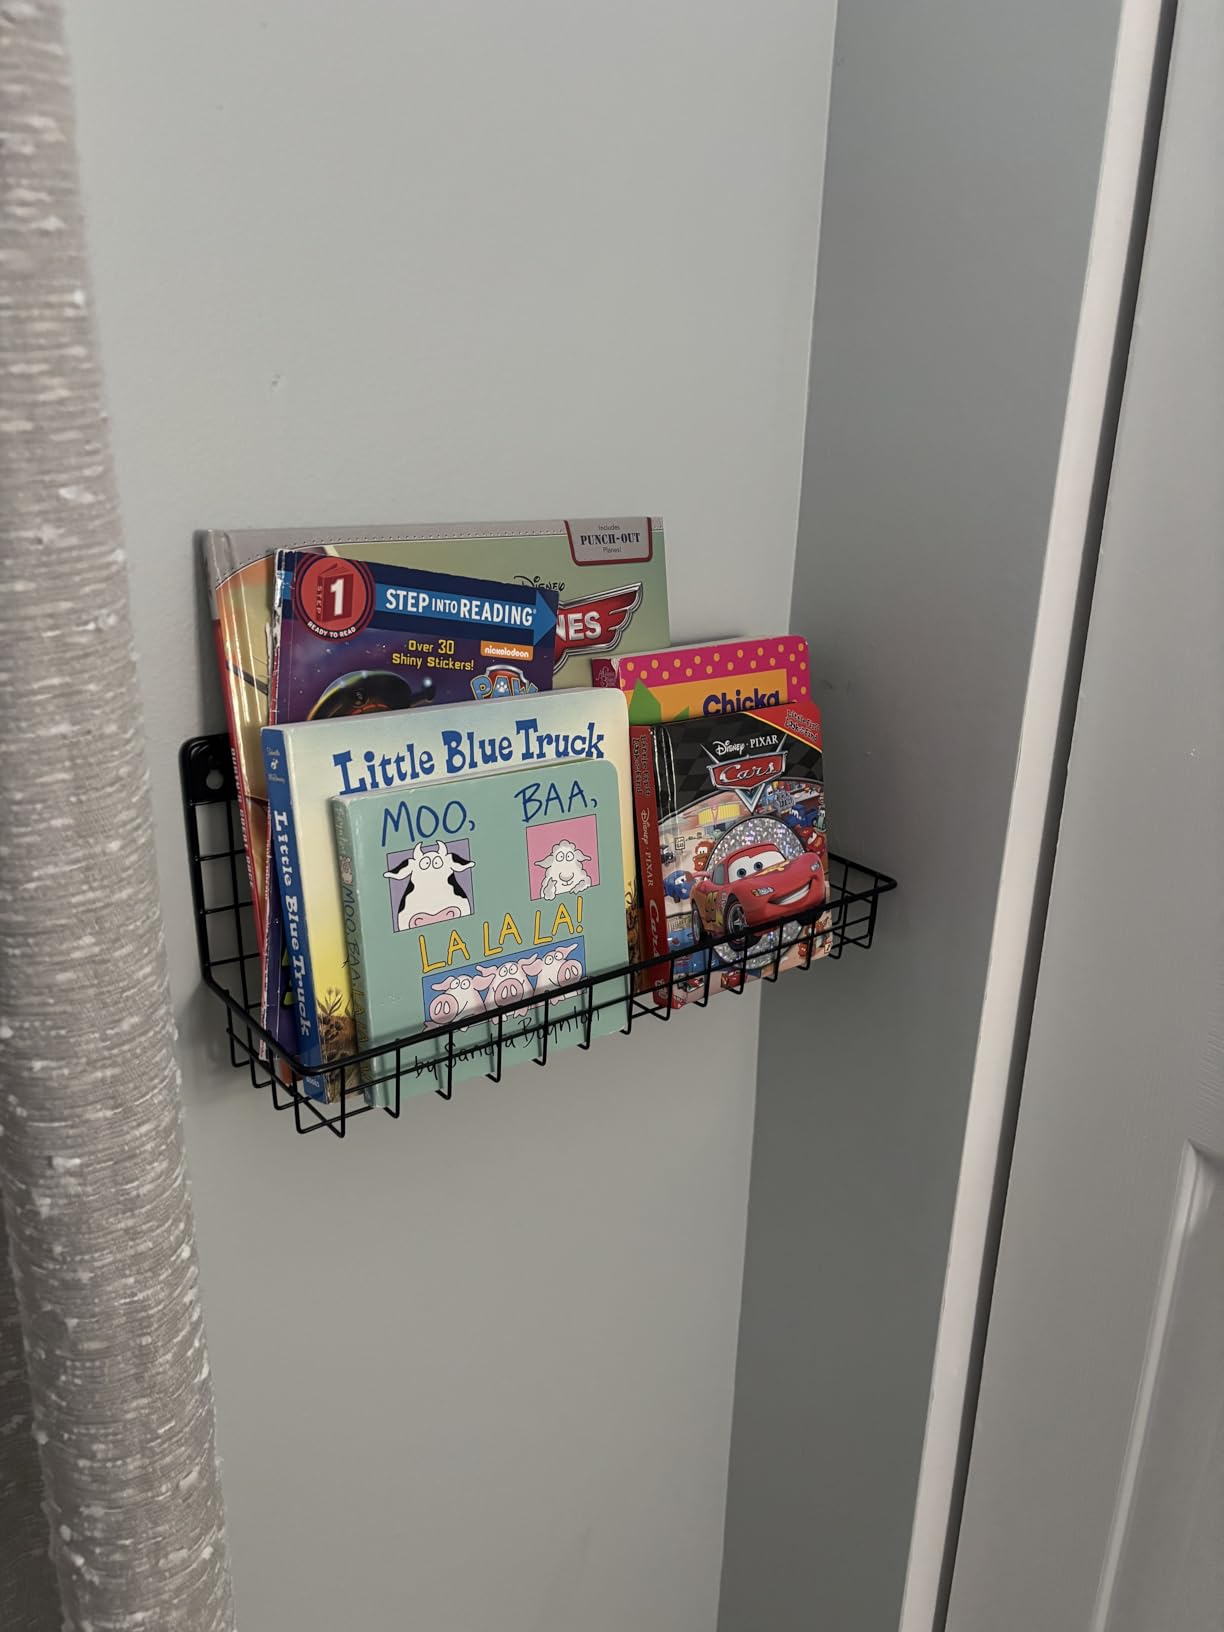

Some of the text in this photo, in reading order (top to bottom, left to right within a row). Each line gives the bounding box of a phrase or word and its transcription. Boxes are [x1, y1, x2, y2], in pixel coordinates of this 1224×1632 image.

[580, 532, 641, 546] PUNCH-OUT
[329, 577, 345, 617] 1
[386, 588, 430, 613] STEP
[431, 597, 458, 615] INTO
[306, 620, 357, 639] READY TO READ
[407, 638, 456, 655] Over 30
[483, 647, 530, 659] nickelodeon
[391, 652, 475, 672] Shiny Stickers!
[702, 687, 781, 716] Chicka
[749, 734, 779, 749] PIXAR
[332, 717, 605, 796] Little Blue Truck
[719, 761, 777, 783] Cars
[381, 779, 598, 848] MOO, BAA,
[644, 851, 654, 887] PIXAR
[274, 809, 312, 1037] Little Blue Truck
[418, 895, 584, 974] LA LA LA!
[413, 1055, 439, 1081] by
[443, 1031, 516, 1069] Sanda
